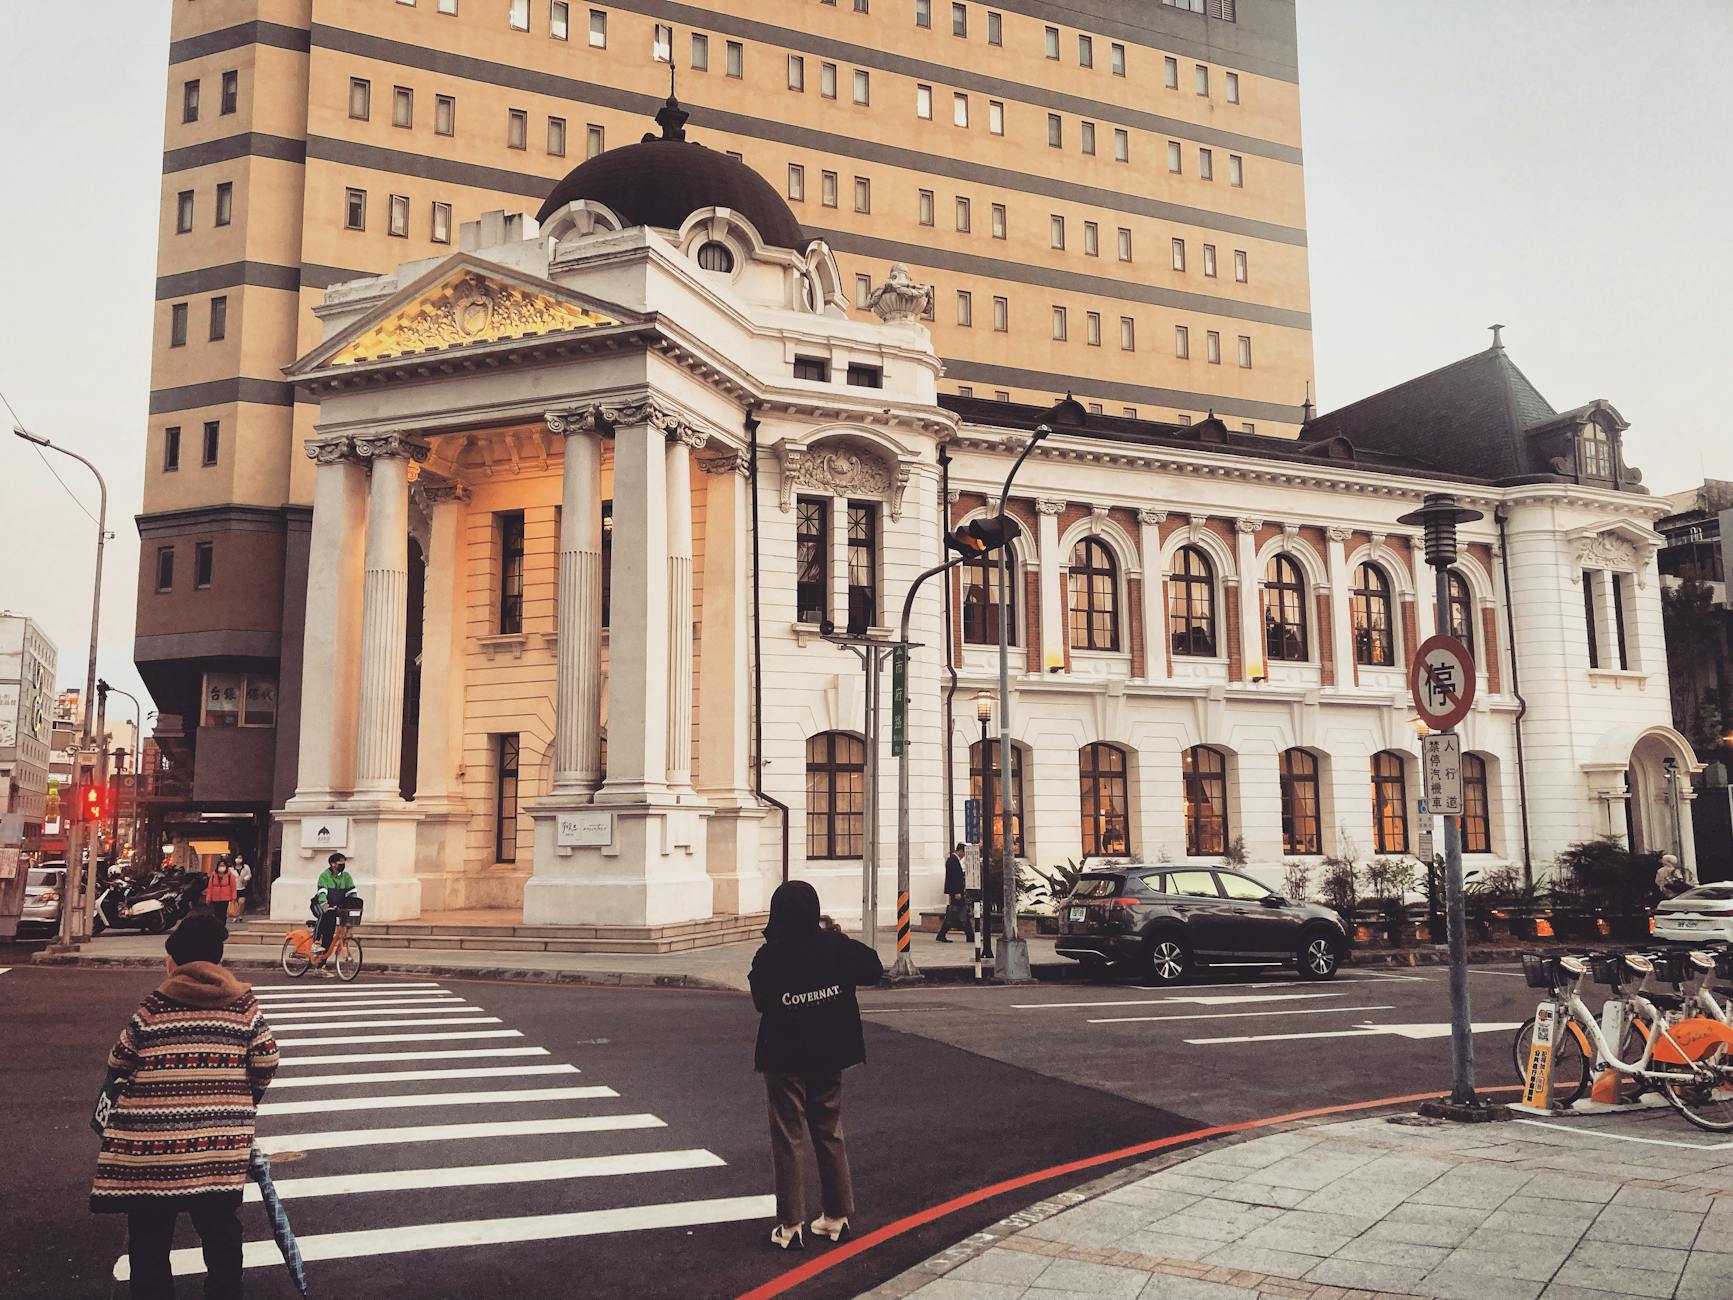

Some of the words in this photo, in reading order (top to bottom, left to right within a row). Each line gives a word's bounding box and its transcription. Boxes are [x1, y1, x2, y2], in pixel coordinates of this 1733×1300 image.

[894, 661, 903, 729] 市府路
[1425, 662, 1456, 707] 停
[1429, 740, 1442, 809] 禁停汽機車
[1444, 739, 1457, 809] 人行道
